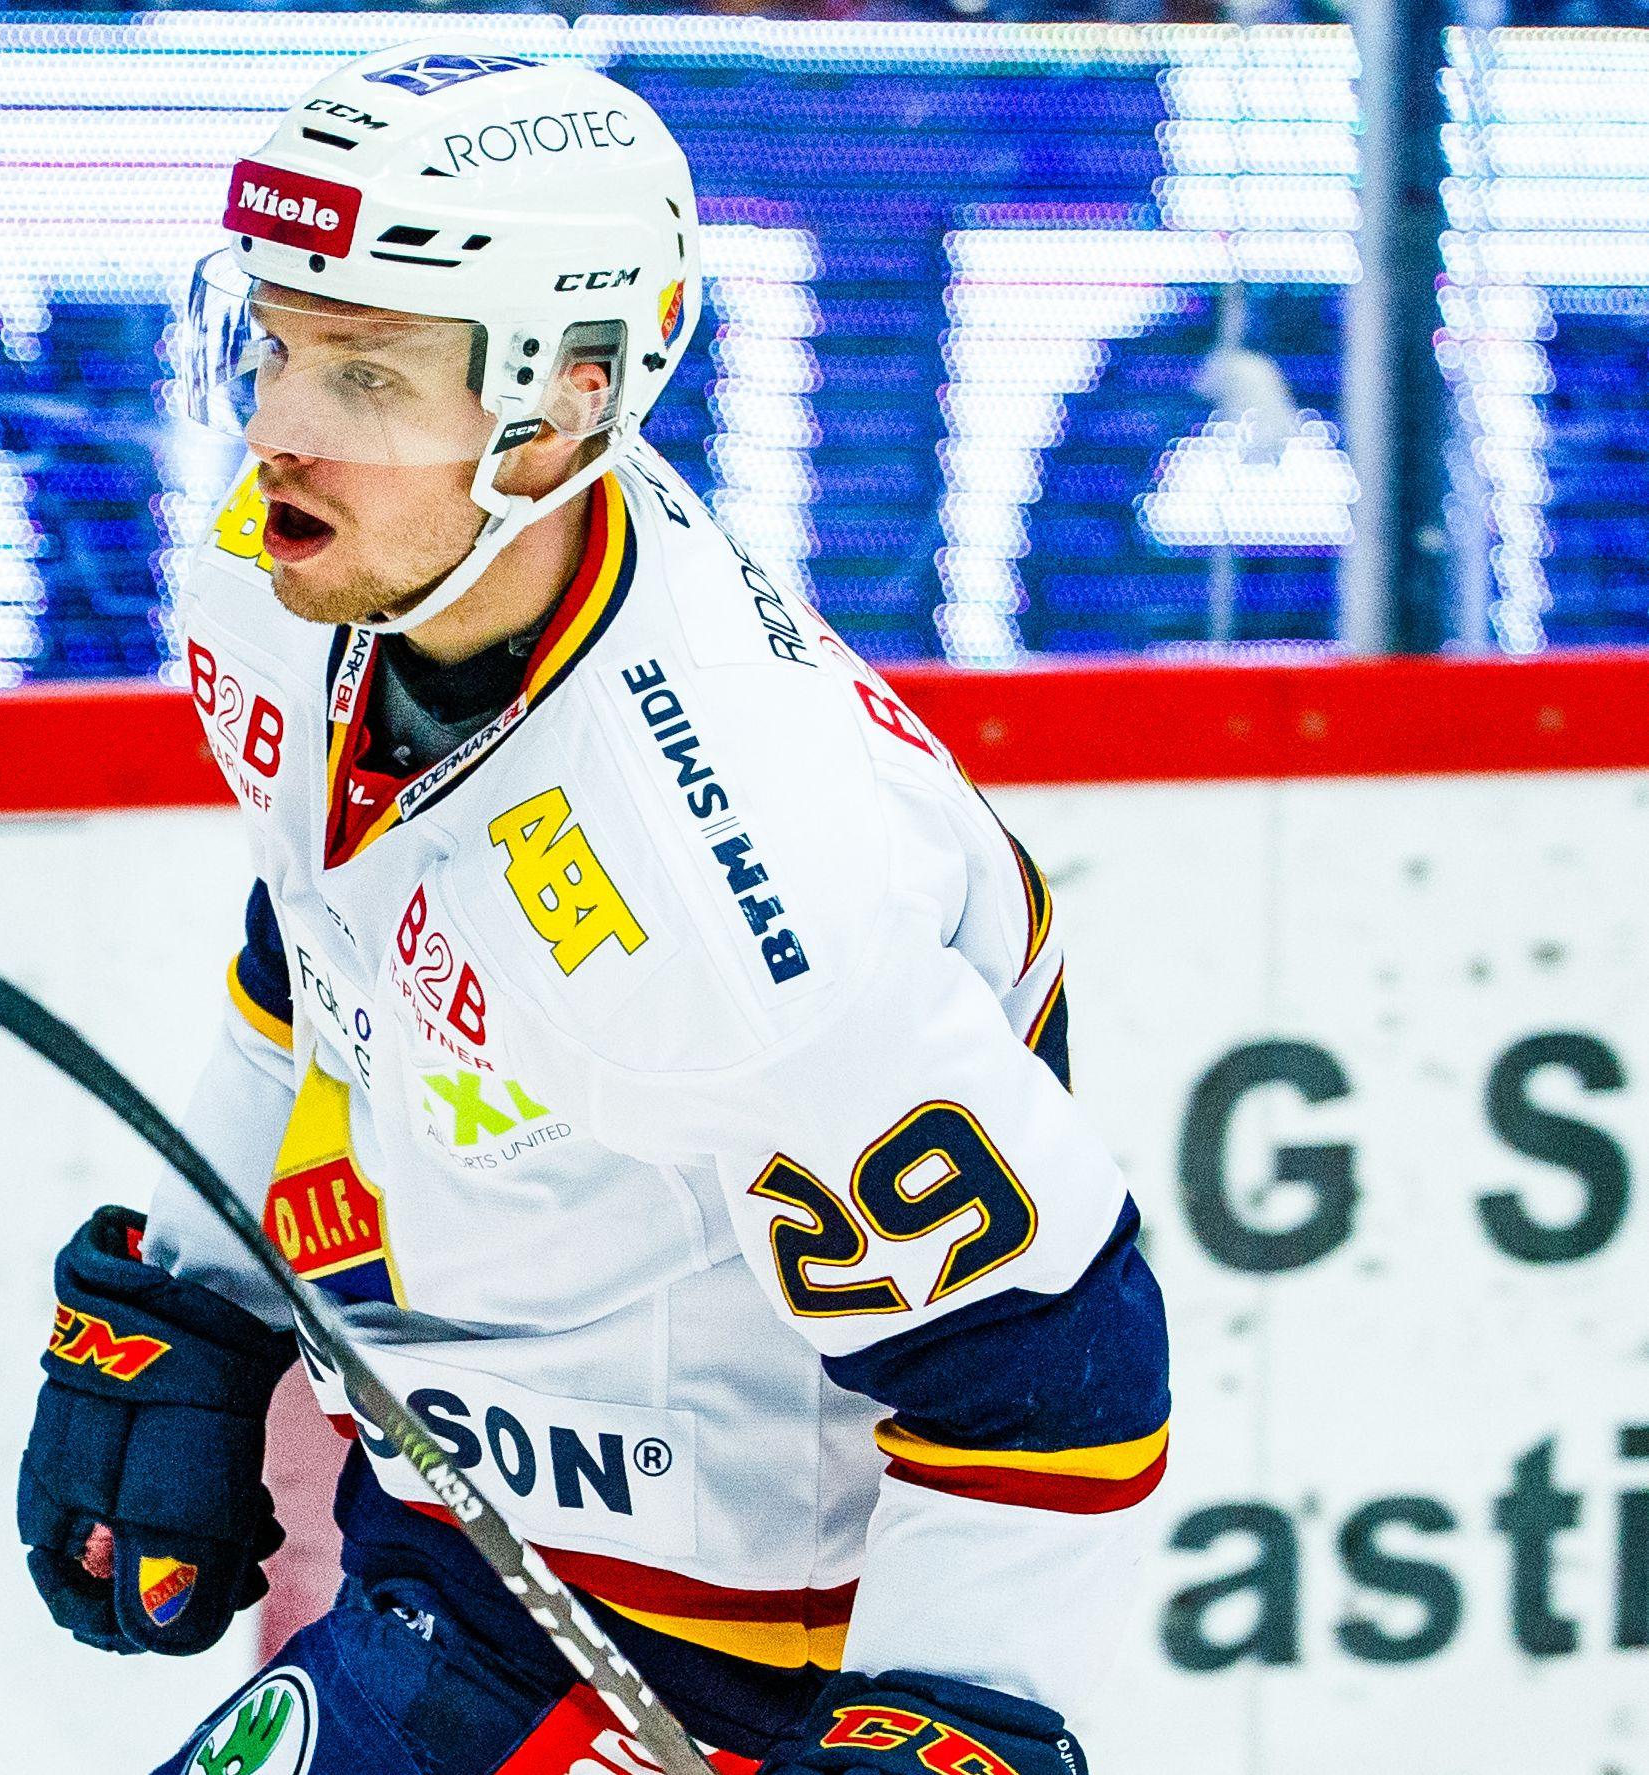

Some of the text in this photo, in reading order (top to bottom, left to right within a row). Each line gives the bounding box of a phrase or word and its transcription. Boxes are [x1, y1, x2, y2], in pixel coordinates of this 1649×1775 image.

[303, 99, 389, 130] CCM
[444, 110, 635, 172] ROTOTEC
[237, 180, 340, 232] Miele
[554, 266, 641, 292] CCM
[504, 424, 540, 438] CCM
[188, 636, 284, 778] B2B
[332, 684, 354, 719] BIL
[399, 718, 502, 815] RIDDERMARK
[621, 658, 729, 820] SMIDE
[396, 882, 486, 1047] B2B
[501, 1122, 572, 1161] UNITED
[748, 1098, 1039, 1320] 29
